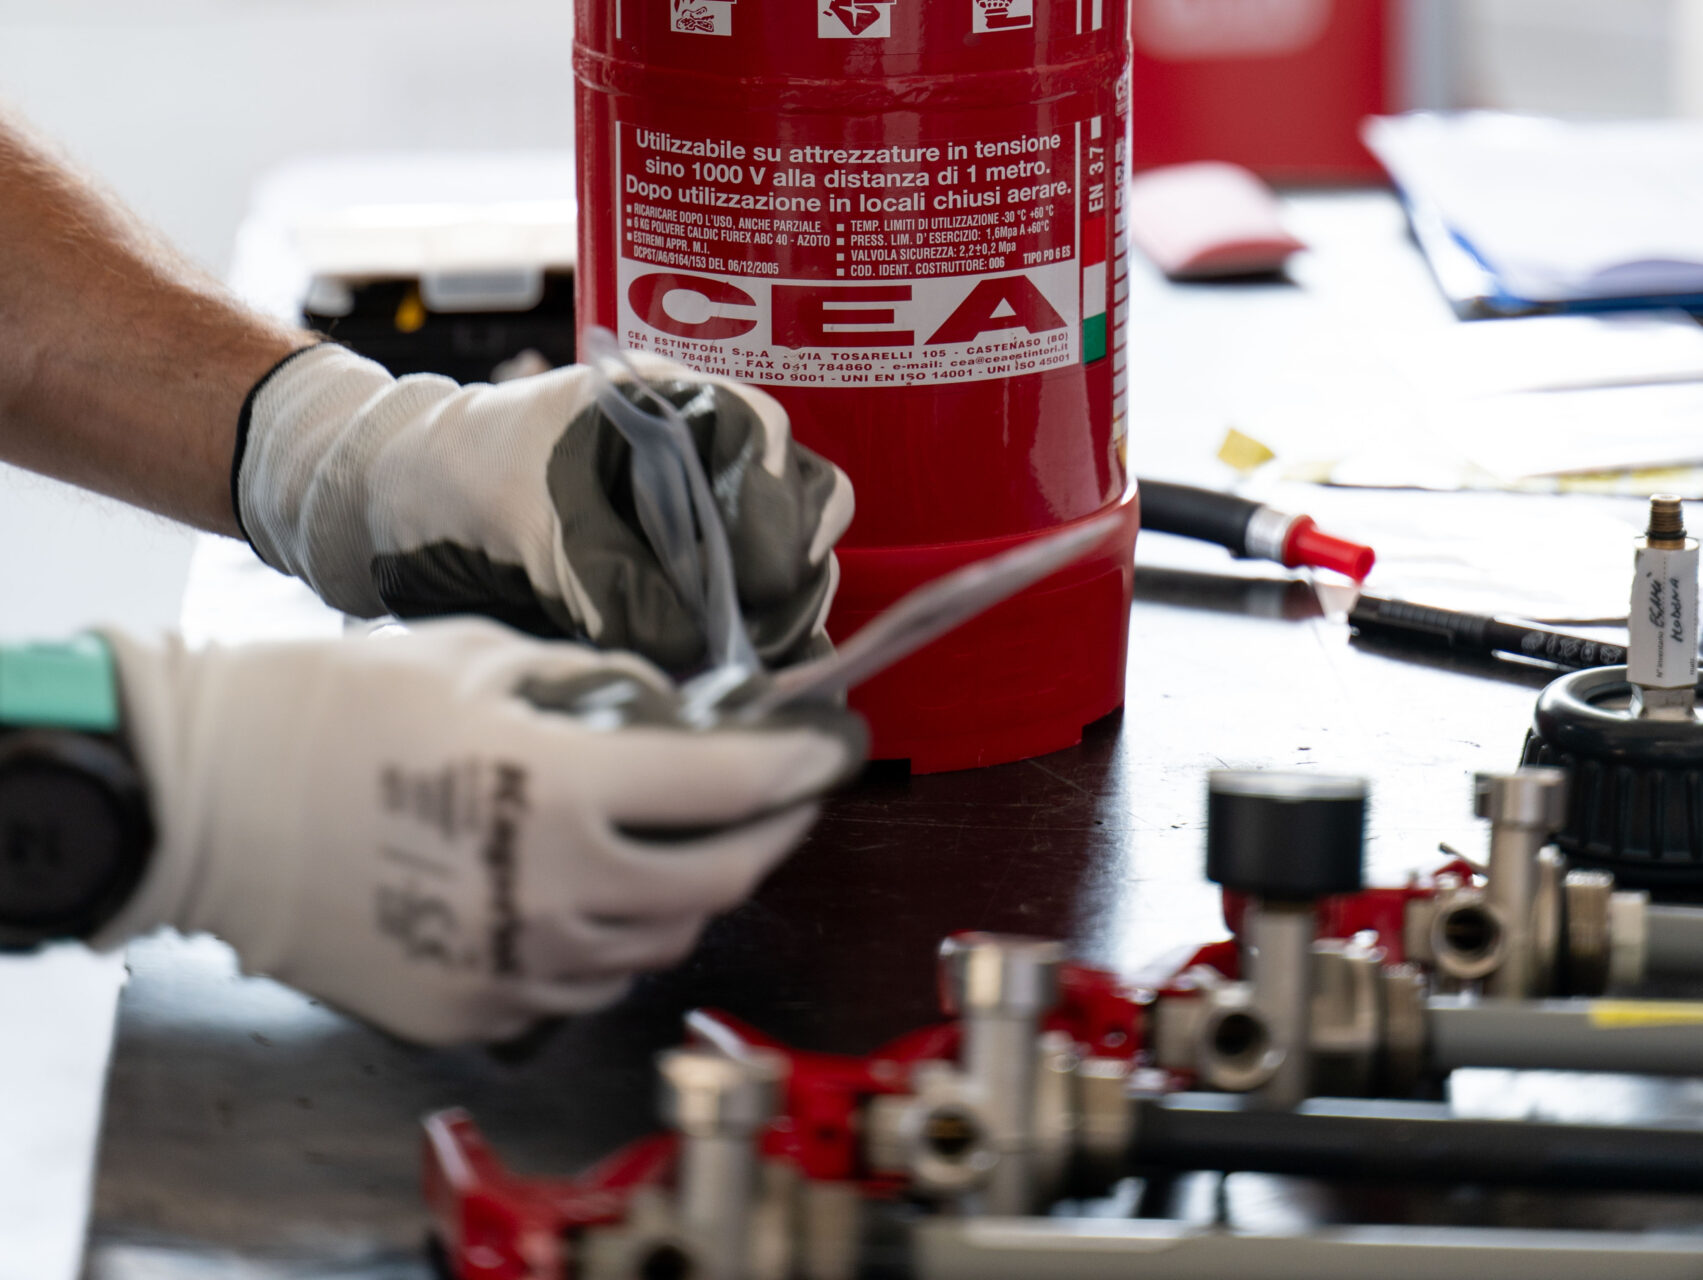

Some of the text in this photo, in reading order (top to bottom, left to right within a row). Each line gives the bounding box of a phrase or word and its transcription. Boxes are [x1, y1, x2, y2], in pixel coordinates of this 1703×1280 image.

[636, 128, 1061, 164] Utilizzabile su attrezzature in tensione
[645, 157, 1050, 188] sino 1000 V alla distanza di 1 metro.
[626, 174, 1071, 212] Dopo utilizzazione in locali chiusi aerare.
[1088, 182, 1104, 213] EN
[634, 203, 677, 221] RICARICARE
[680, 211, 703, 225] DOPO
[738, 217, 771, 231] ANCHE
[773, 219, 821, 232] PARZIALE
[851, 220, 881, 232] TEMP.
[884, 219, 915, 231] LIMITI
[918, 217, 929, 230] DI
[931, 212, 999, 229] UTILIZZAZIONE
[634, 232, 664, 248] ESTREMI
[666, 238, 690, 252] APPR.
[640, 219, 650, 230] KG
[651, 221, 685, 237] POLVERE
[687, 225, 718, 240] CALDIC
[721, 229, 751, 243] FUREX
[753, 232, 773, 244] ABC
[776, 233, 788, 245] 40
[797, 234, 830, 247] AZOTO
[851, 234, 887, 247] PRESS.
[891, 233, 913, 246] LIM.
[1019, 224, 1025, 236] A
[708, 257, 726, 270] DEL
[728, 259, 779, 275] 06/12/2005
[850, 257, 1005, 277] COD. IDENT. COSTRUTTORE: 006
[851, 247, 897, 261] VALVOLA
[899, 245, 957, 261] SICUREZZA:
[1023, 251, 1042, 265] TIPO
[628, 273, 1068, 347] CEA
[628, 331, 647, 342] CEA
[655, 337, 723, 354] ESTINTORI
[798, 352, 821, 360] VIA
[831, 351, 913, 361] TOSARELLI
[923, 350, 946, 358] 105
[967, 337, 1041, 355] CASTENASO
[1047, 332, 1068, 345] (BO)
[682, 352, 726, 364] 784811
[747, 360, 774, 369] FAX
[818, 362, 872, 371] 784860
[893, 361, 943, 370] e-mail:
[706, 366, 730, 376] UNI
[736, 370, 754, 378] EN
[760, 371, 785, 381] ISO
[790, 373, 825, 382] 9001
[842, 374, 868, 383] UNI
[875, 373, 895, 382] EN
[900, 372, 926, 382] ISO
[932, 369, 973, 379] 14001
[987, 364, 1011, 375] UNI
[1015, 360, 1035, 370] ISO
[1039, 353, 1070, 367] 45001
